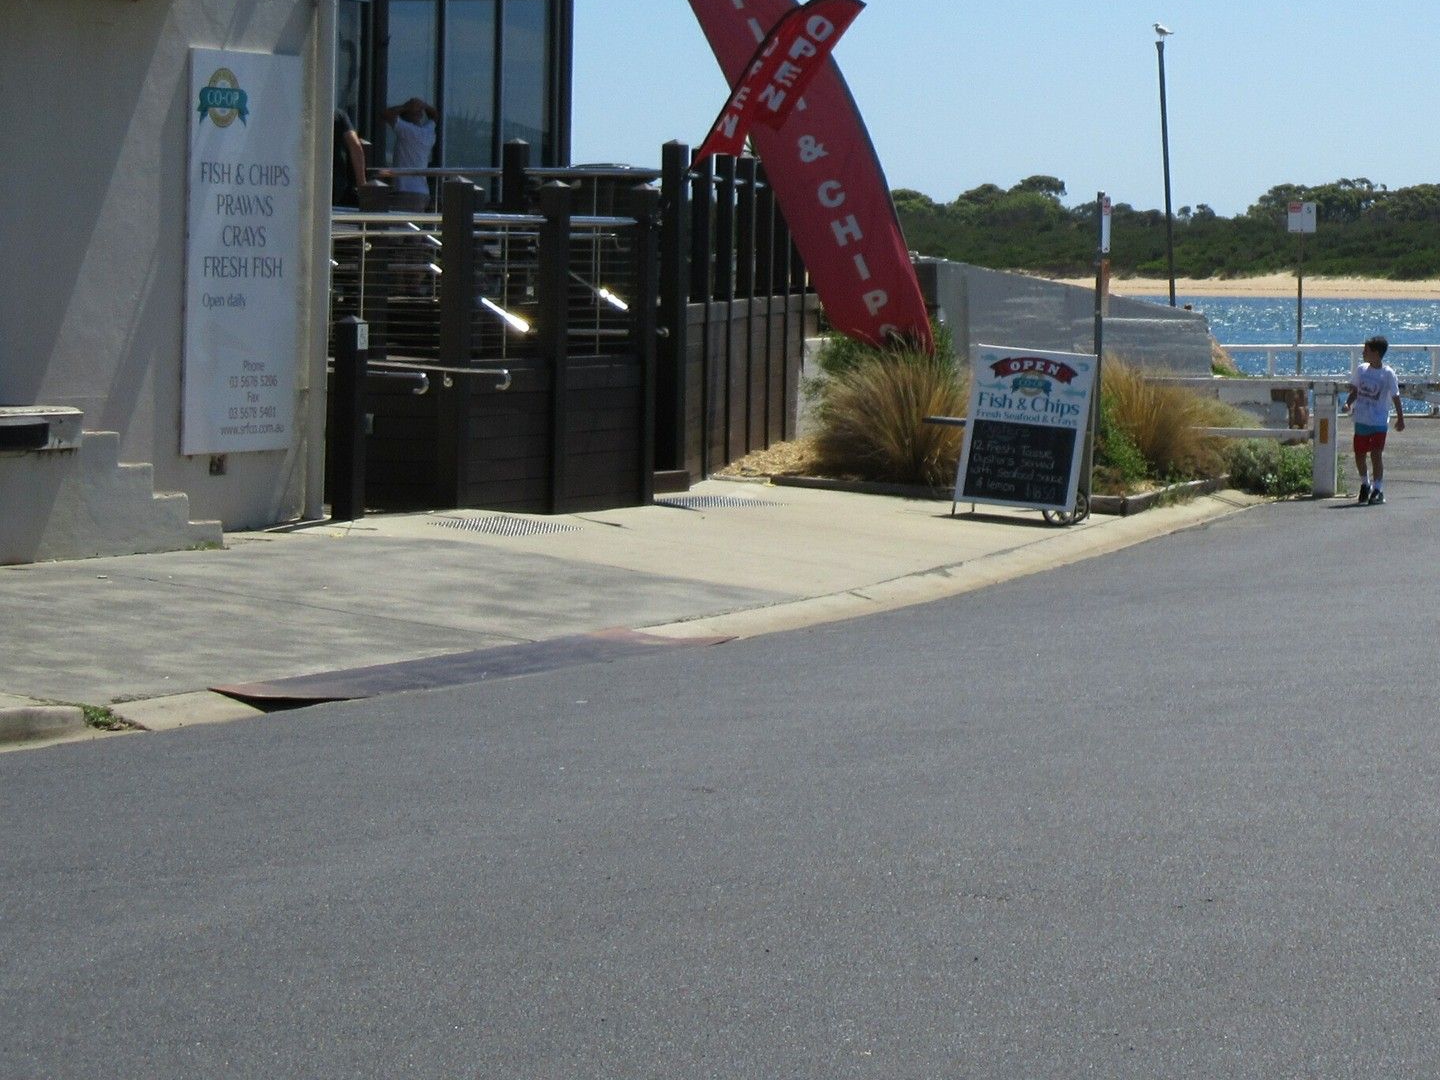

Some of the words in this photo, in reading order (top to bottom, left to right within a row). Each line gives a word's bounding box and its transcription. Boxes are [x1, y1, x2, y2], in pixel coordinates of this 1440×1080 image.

[757, 14, 835, 112] OPEN
[796, 134, 828, 163] &
[200, 161, 232, 185] FISH
[235, 163, 245, 186] &
[248, 164, 290, 187] CHIPS
[216, 193, 274, 217] PRAWNS
[221, 225, 267, 248] CRAYS
[203, 256, 248, 279] FRESH
[253, 256, 283, 279] FISH
[202, 292, 225, 310] Open
[227, 292, 248, 310] daily
[243, 360, 265, 373] Phone
[1009, 358, 1061, 376] OPEN
[247, 390, 260, 404] Fax
[977, 391, 1013, 410] Fish
[1016, 398, 1028, 410] &
[1031, 398, 1080, 418] Chips
[975, 408, 1002, 419] Fresh
[1003, 411, 1040, 423] Seafood
[1050, 415, 1078, 426] Crays
